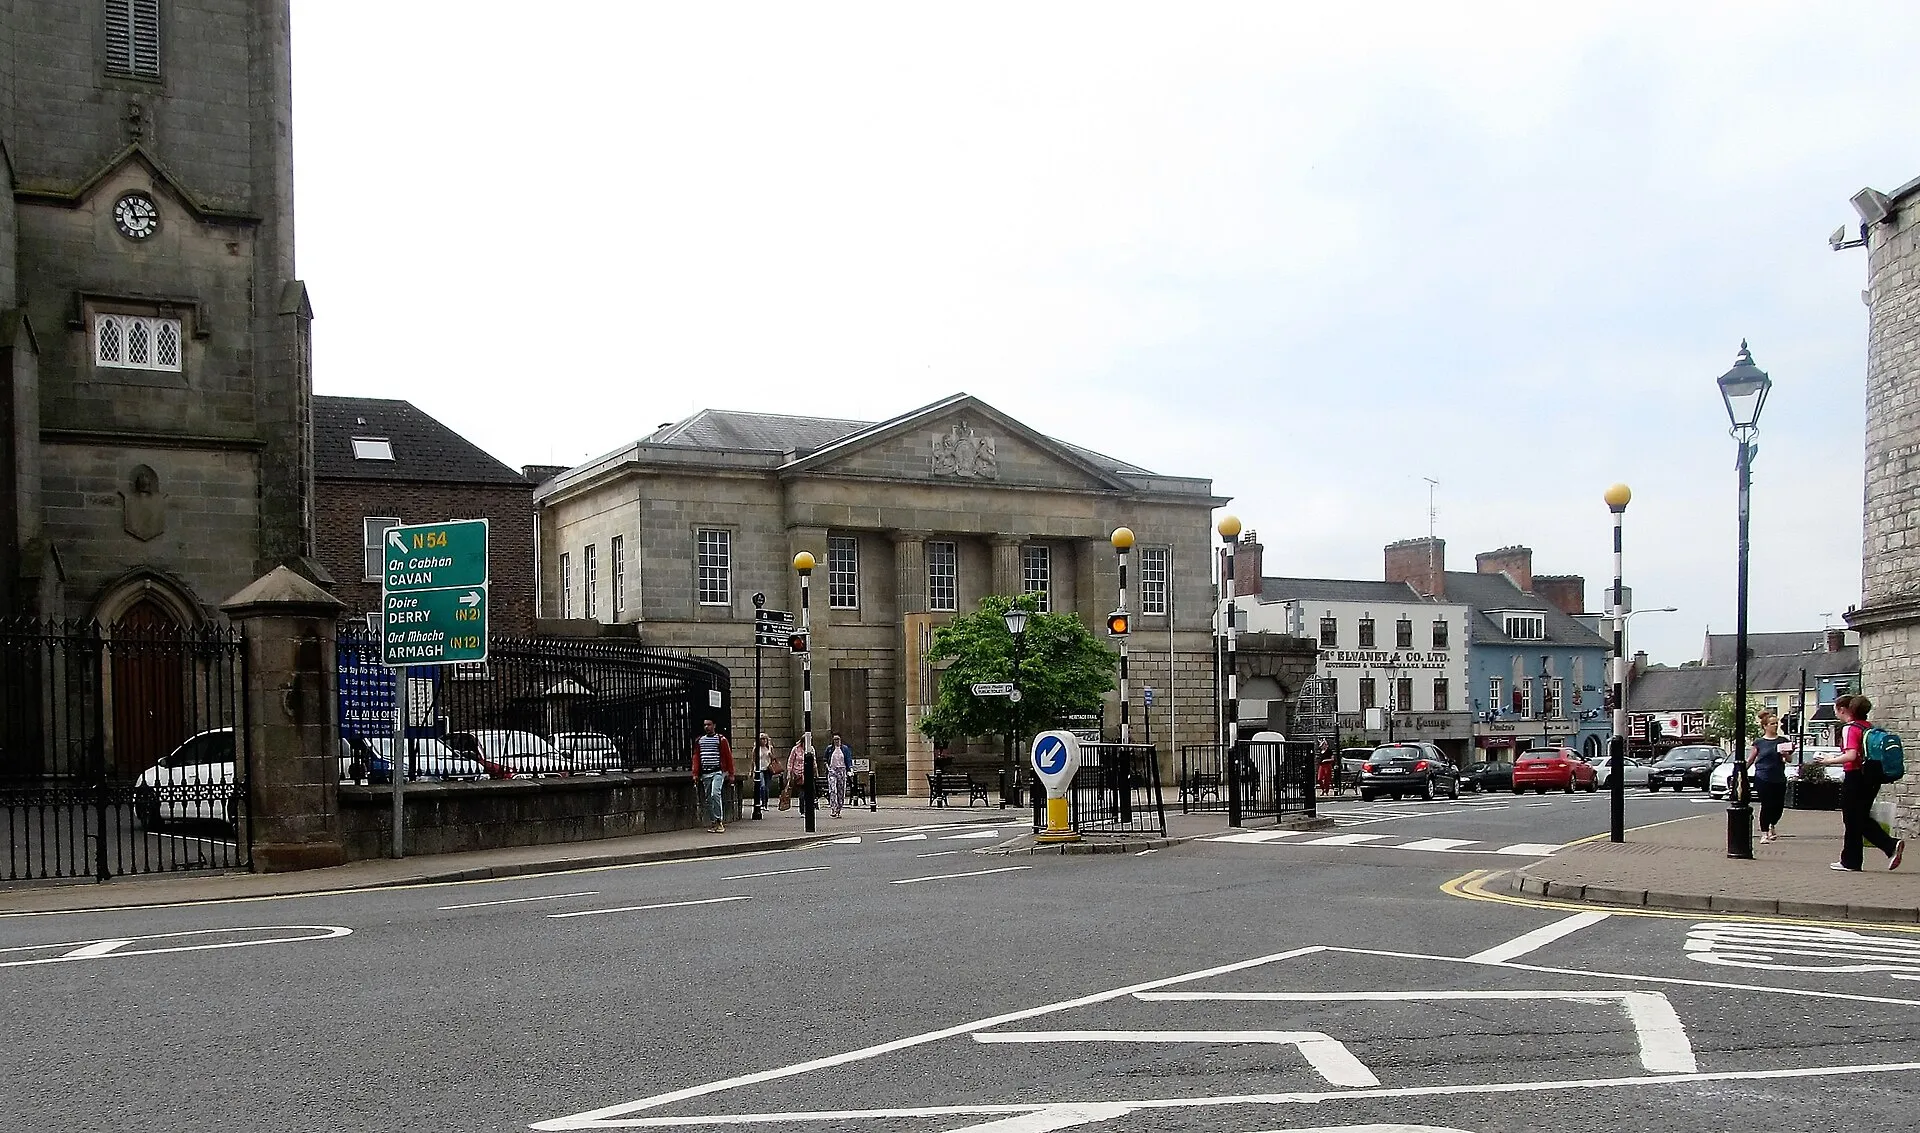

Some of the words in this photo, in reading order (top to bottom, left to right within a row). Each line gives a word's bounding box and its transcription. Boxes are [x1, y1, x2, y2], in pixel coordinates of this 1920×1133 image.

[389, 572, 432, 585] CAVAN
[388, 597, 418, 609] Doire
[389, 610, 431, 624] DERRY
[407, 629, 444, 642] Mhacha
[388, 645, 444, 658] ARMAGH
